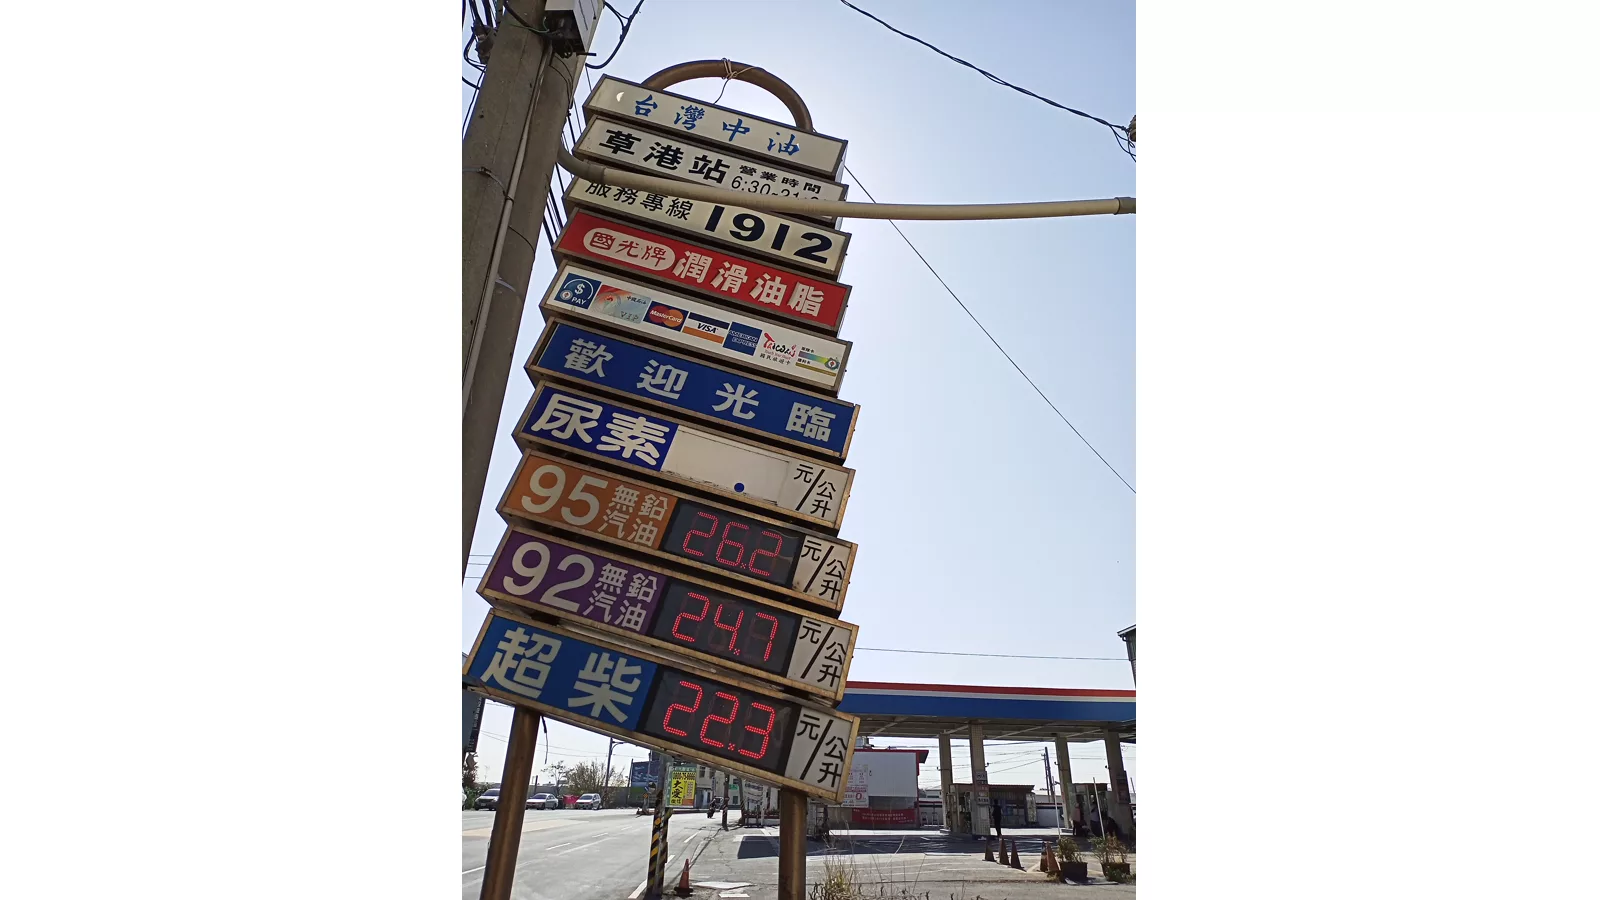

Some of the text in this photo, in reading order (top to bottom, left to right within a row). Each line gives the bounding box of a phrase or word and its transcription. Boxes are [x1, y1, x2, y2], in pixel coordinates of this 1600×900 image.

[635, 95, 800, 156] 台灣中油
[599, 129, 731, 185] 草港站
[739, 165, 822, 194] 營業時間
[585, 182, 694, 220] 服務專線
[590, 231, 667, 267] 國光牌
[704, 205, 834, 264] 1912
[571, 296, 587, 305] PAY
[672, 250, 825, 317] 潤滑油脂
[620, 311, 639, 321] VIP
[650, 309, 682, 323] MasterCard
[697, 323, 717, 334] VISA
[564, 337, 836, 443] 歡迎光臨
[531, 393, 670, 466] 尿素
[521, 465, 609, 526] 95
[682, 511, 783, 576] 26.2
[502, 541, 596, 613] 92
[671, 592, 779, 662] 24.7
[481, 627, 643, 724] 超柴
[662, 680, 776, 760] 22.3
